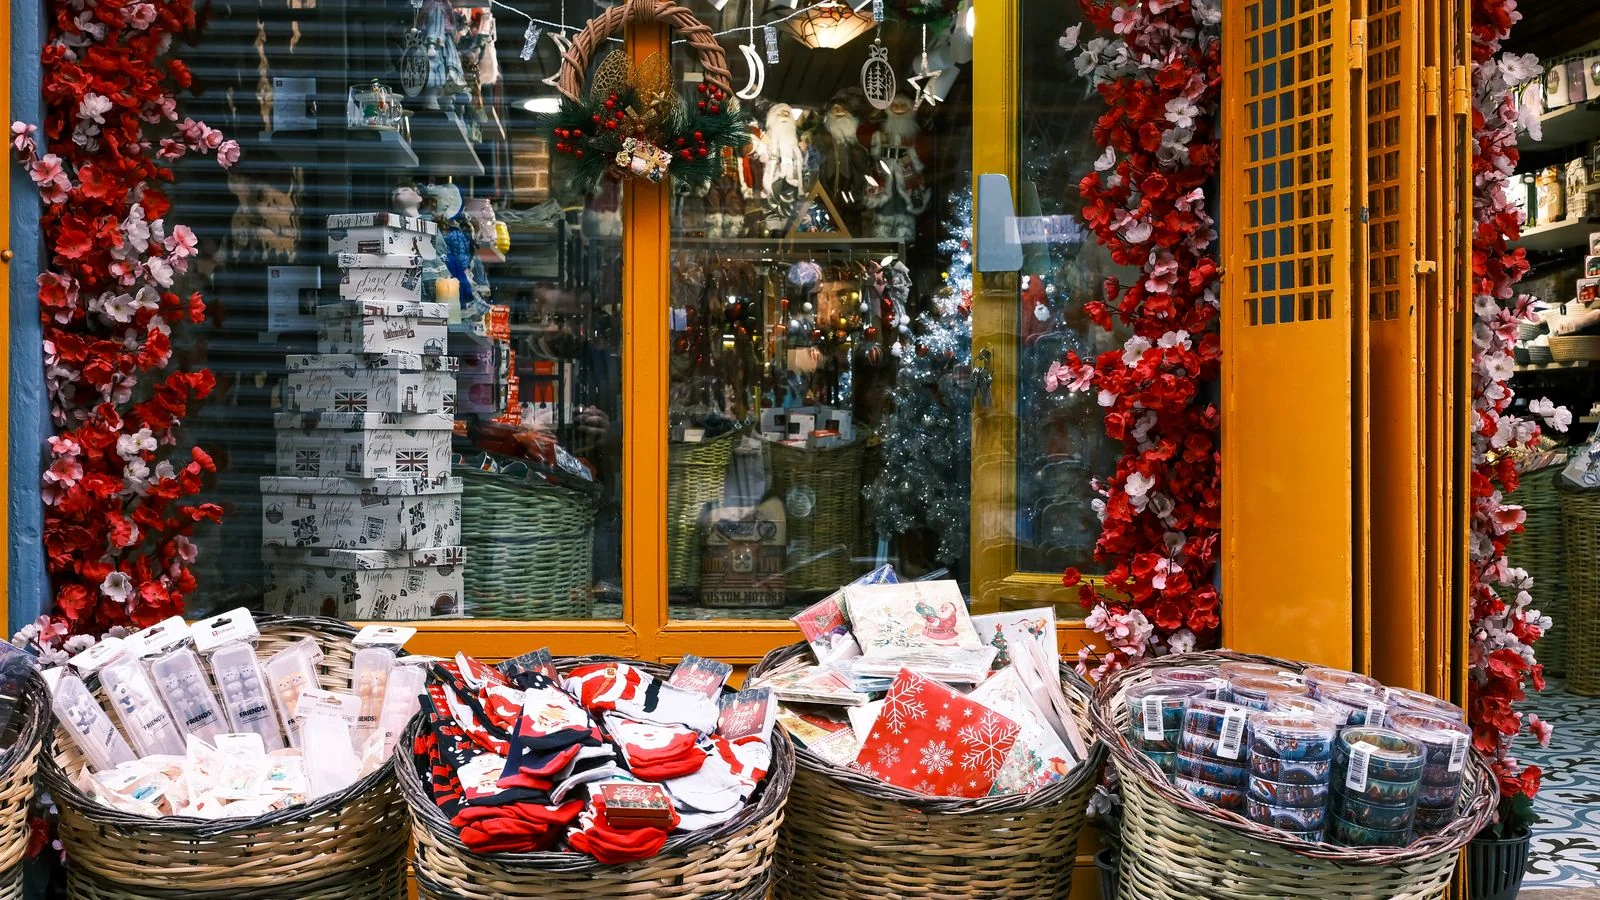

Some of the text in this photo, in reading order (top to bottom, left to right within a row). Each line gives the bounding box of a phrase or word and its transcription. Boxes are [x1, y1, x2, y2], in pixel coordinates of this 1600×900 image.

[352, 277, 386, 294] London
[185, 710, 212, 726] FRIENDS
[238, 705, 266, 718] FRIENDS
[143, 713, 166, 730] FRIENDS
